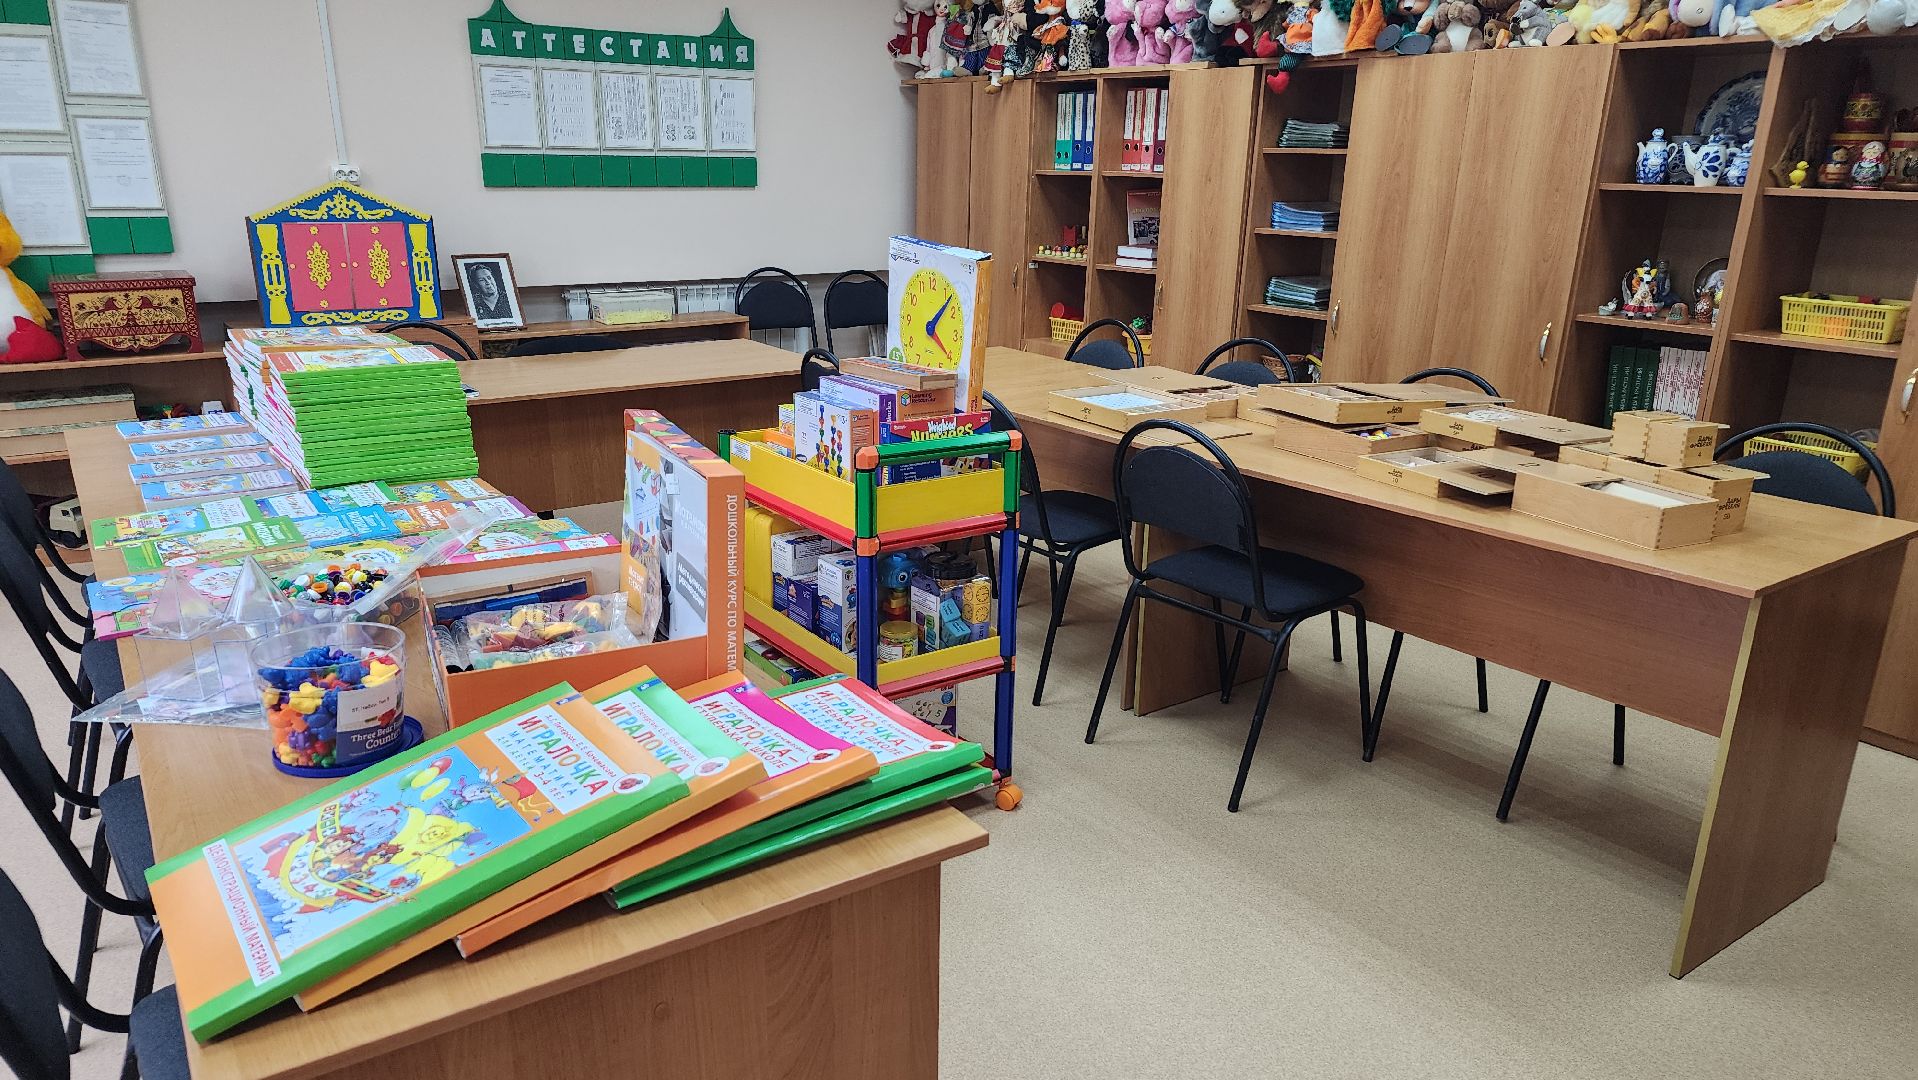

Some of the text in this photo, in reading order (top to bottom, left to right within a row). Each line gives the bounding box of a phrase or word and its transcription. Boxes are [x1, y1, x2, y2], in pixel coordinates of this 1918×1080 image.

[481, 28, 749, 63] АТТЕСТАЦИЯ
[919, 281, 925, 293] 11
[929, 277, 937, 291] 12
[910, 292, 918, 306] 10
[943, 288, 948, 300] 1
[906, 314, 912, 326] 9
[950, 306, 956, 319] 2
[908, 336, 914, 348] 8
[952, 329, 959, 342] 3
[915, 354, 921, 365] 7
[726, 494, 739, 577] ДОШКОЛЬНЫЙ
[727, 579, 737, 609] КУРС
[727, 610, 737, 628] ПО
[350, 732, 377, 743] Three
[376, 725, 394, 737] Bear
[800, 701, 884, 755] МАТЕМАТИКА
[805, 694, 857, 730] СТУПЕНЬКА
[865, 736, 905, 756] ШКОЛЕ
[602, 702, 690, 774] ИГРАЛОЧКА
[693, 705, 744, 742] СТУПЕНЬКА
[753, 746, 789, 769] ШКОЛЕ
[508, 730, 578, 796] МАТЕМАТИКА
[517, 715, 609, 795] ИГРАЛОЧКА
[206, 843, 276, 979] ДЕМОНСТРАЦИОННЫЙ МАТЕРИАЛ
